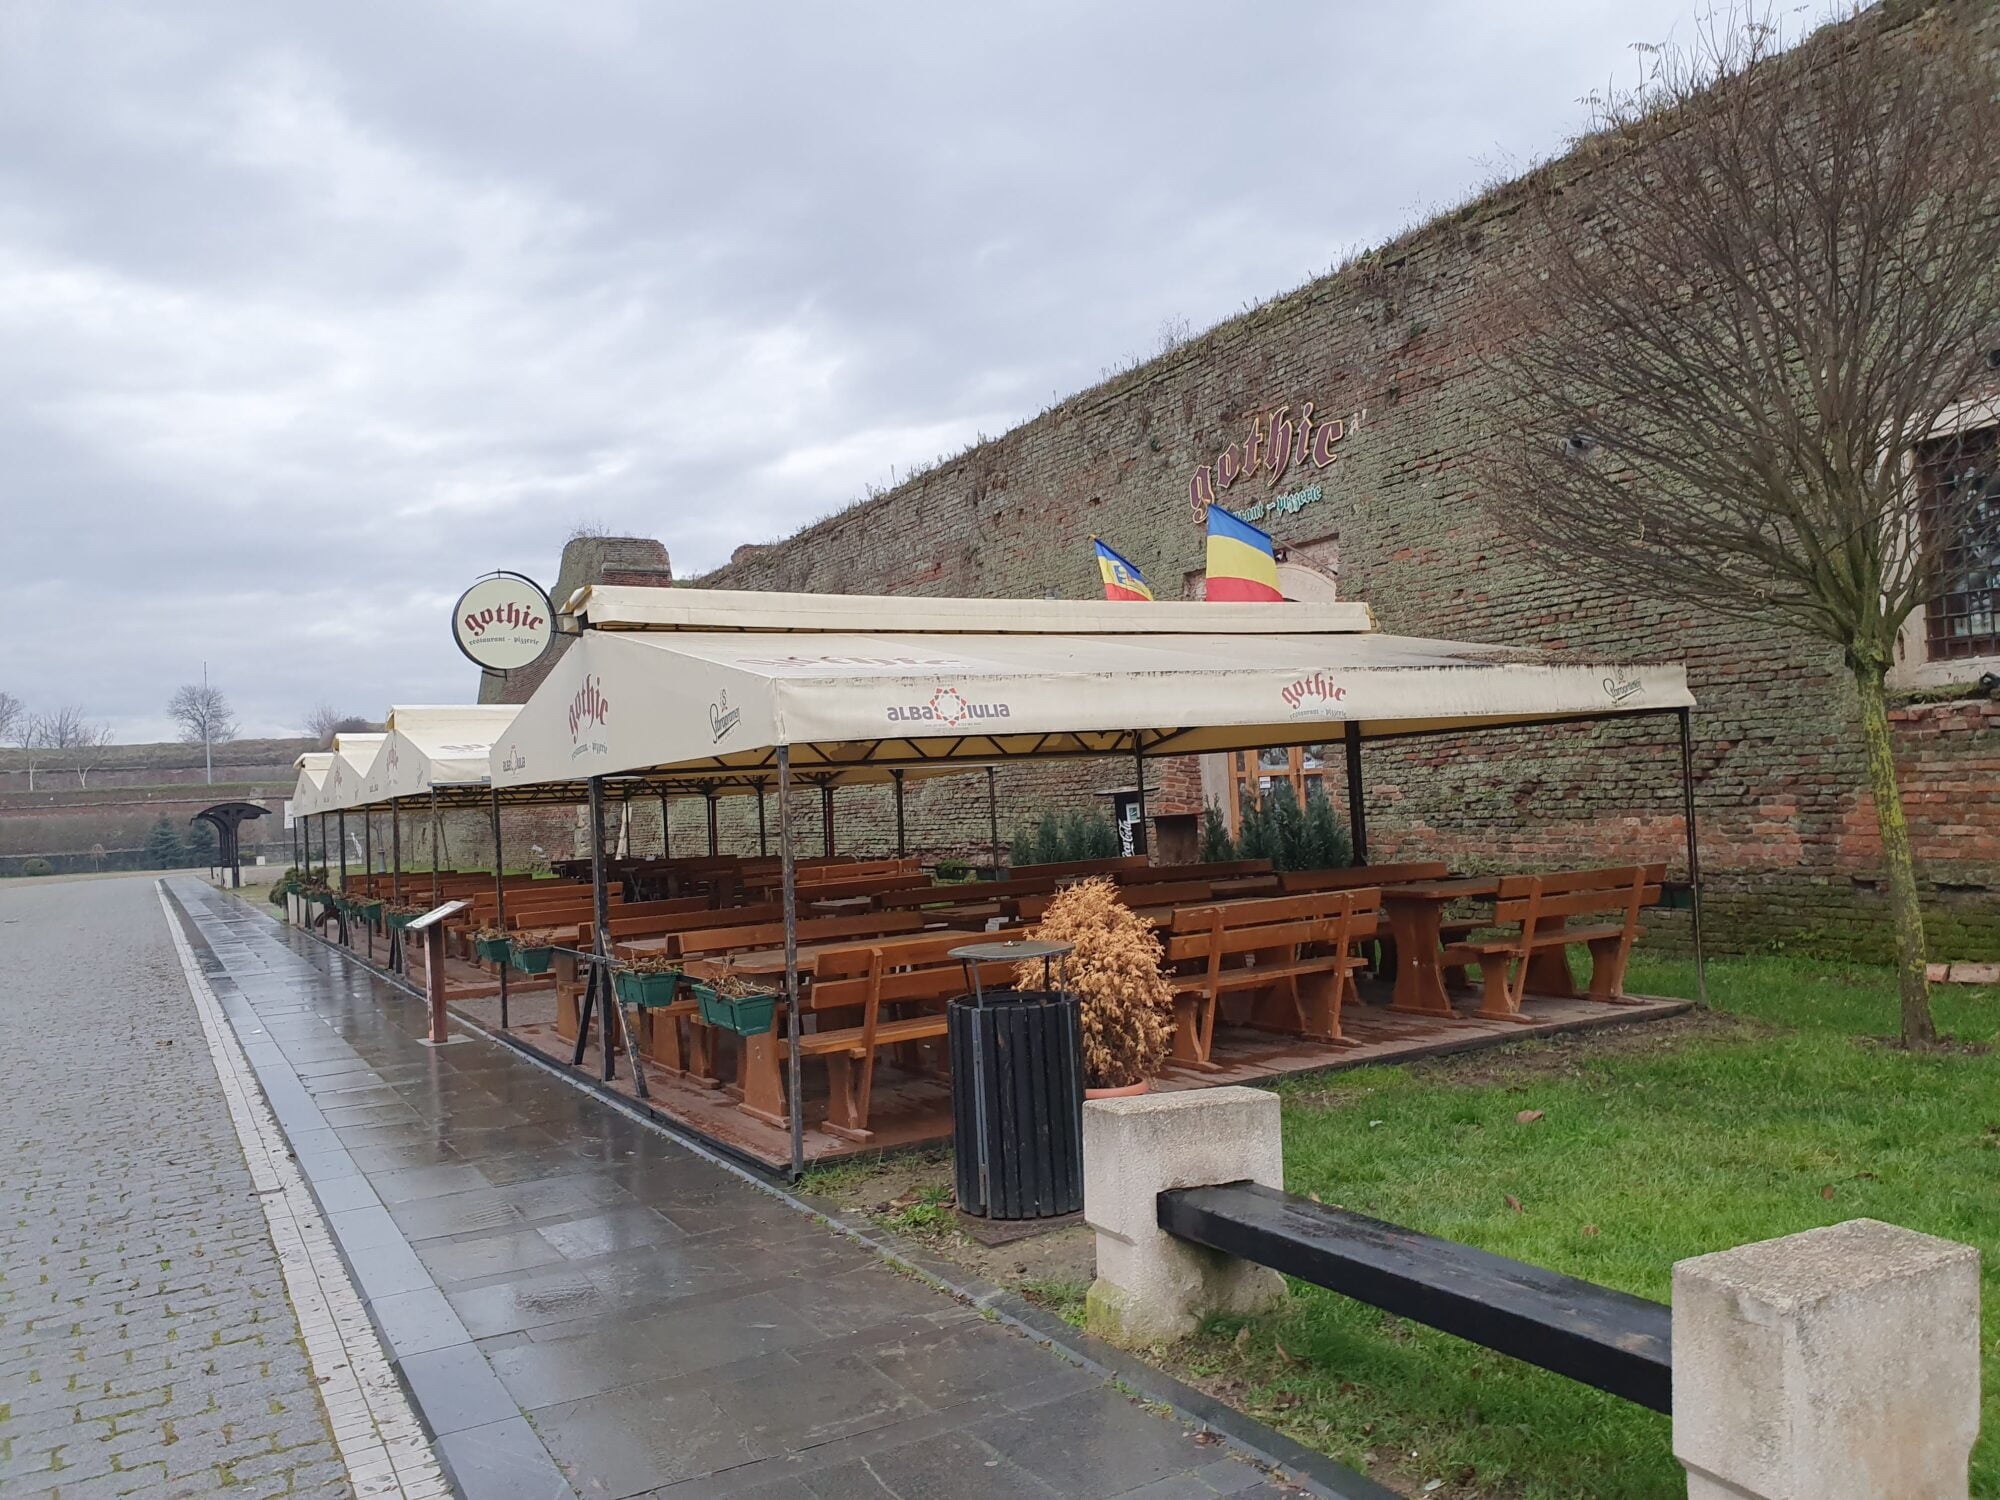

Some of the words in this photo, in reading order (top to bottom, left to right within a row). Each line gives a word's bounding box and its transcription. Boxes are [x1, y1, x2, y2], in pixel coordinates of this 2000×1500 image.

[1189, 402, 1343, 523] gothic
[1277, 484, 1322, 517] pizzerie
[464, 601, 544, 637] gothic
[468, 636, 505, 646] restaurant
[568, 673, 608, 745] gothic
[1281, 671, 1347, 710] gothic
